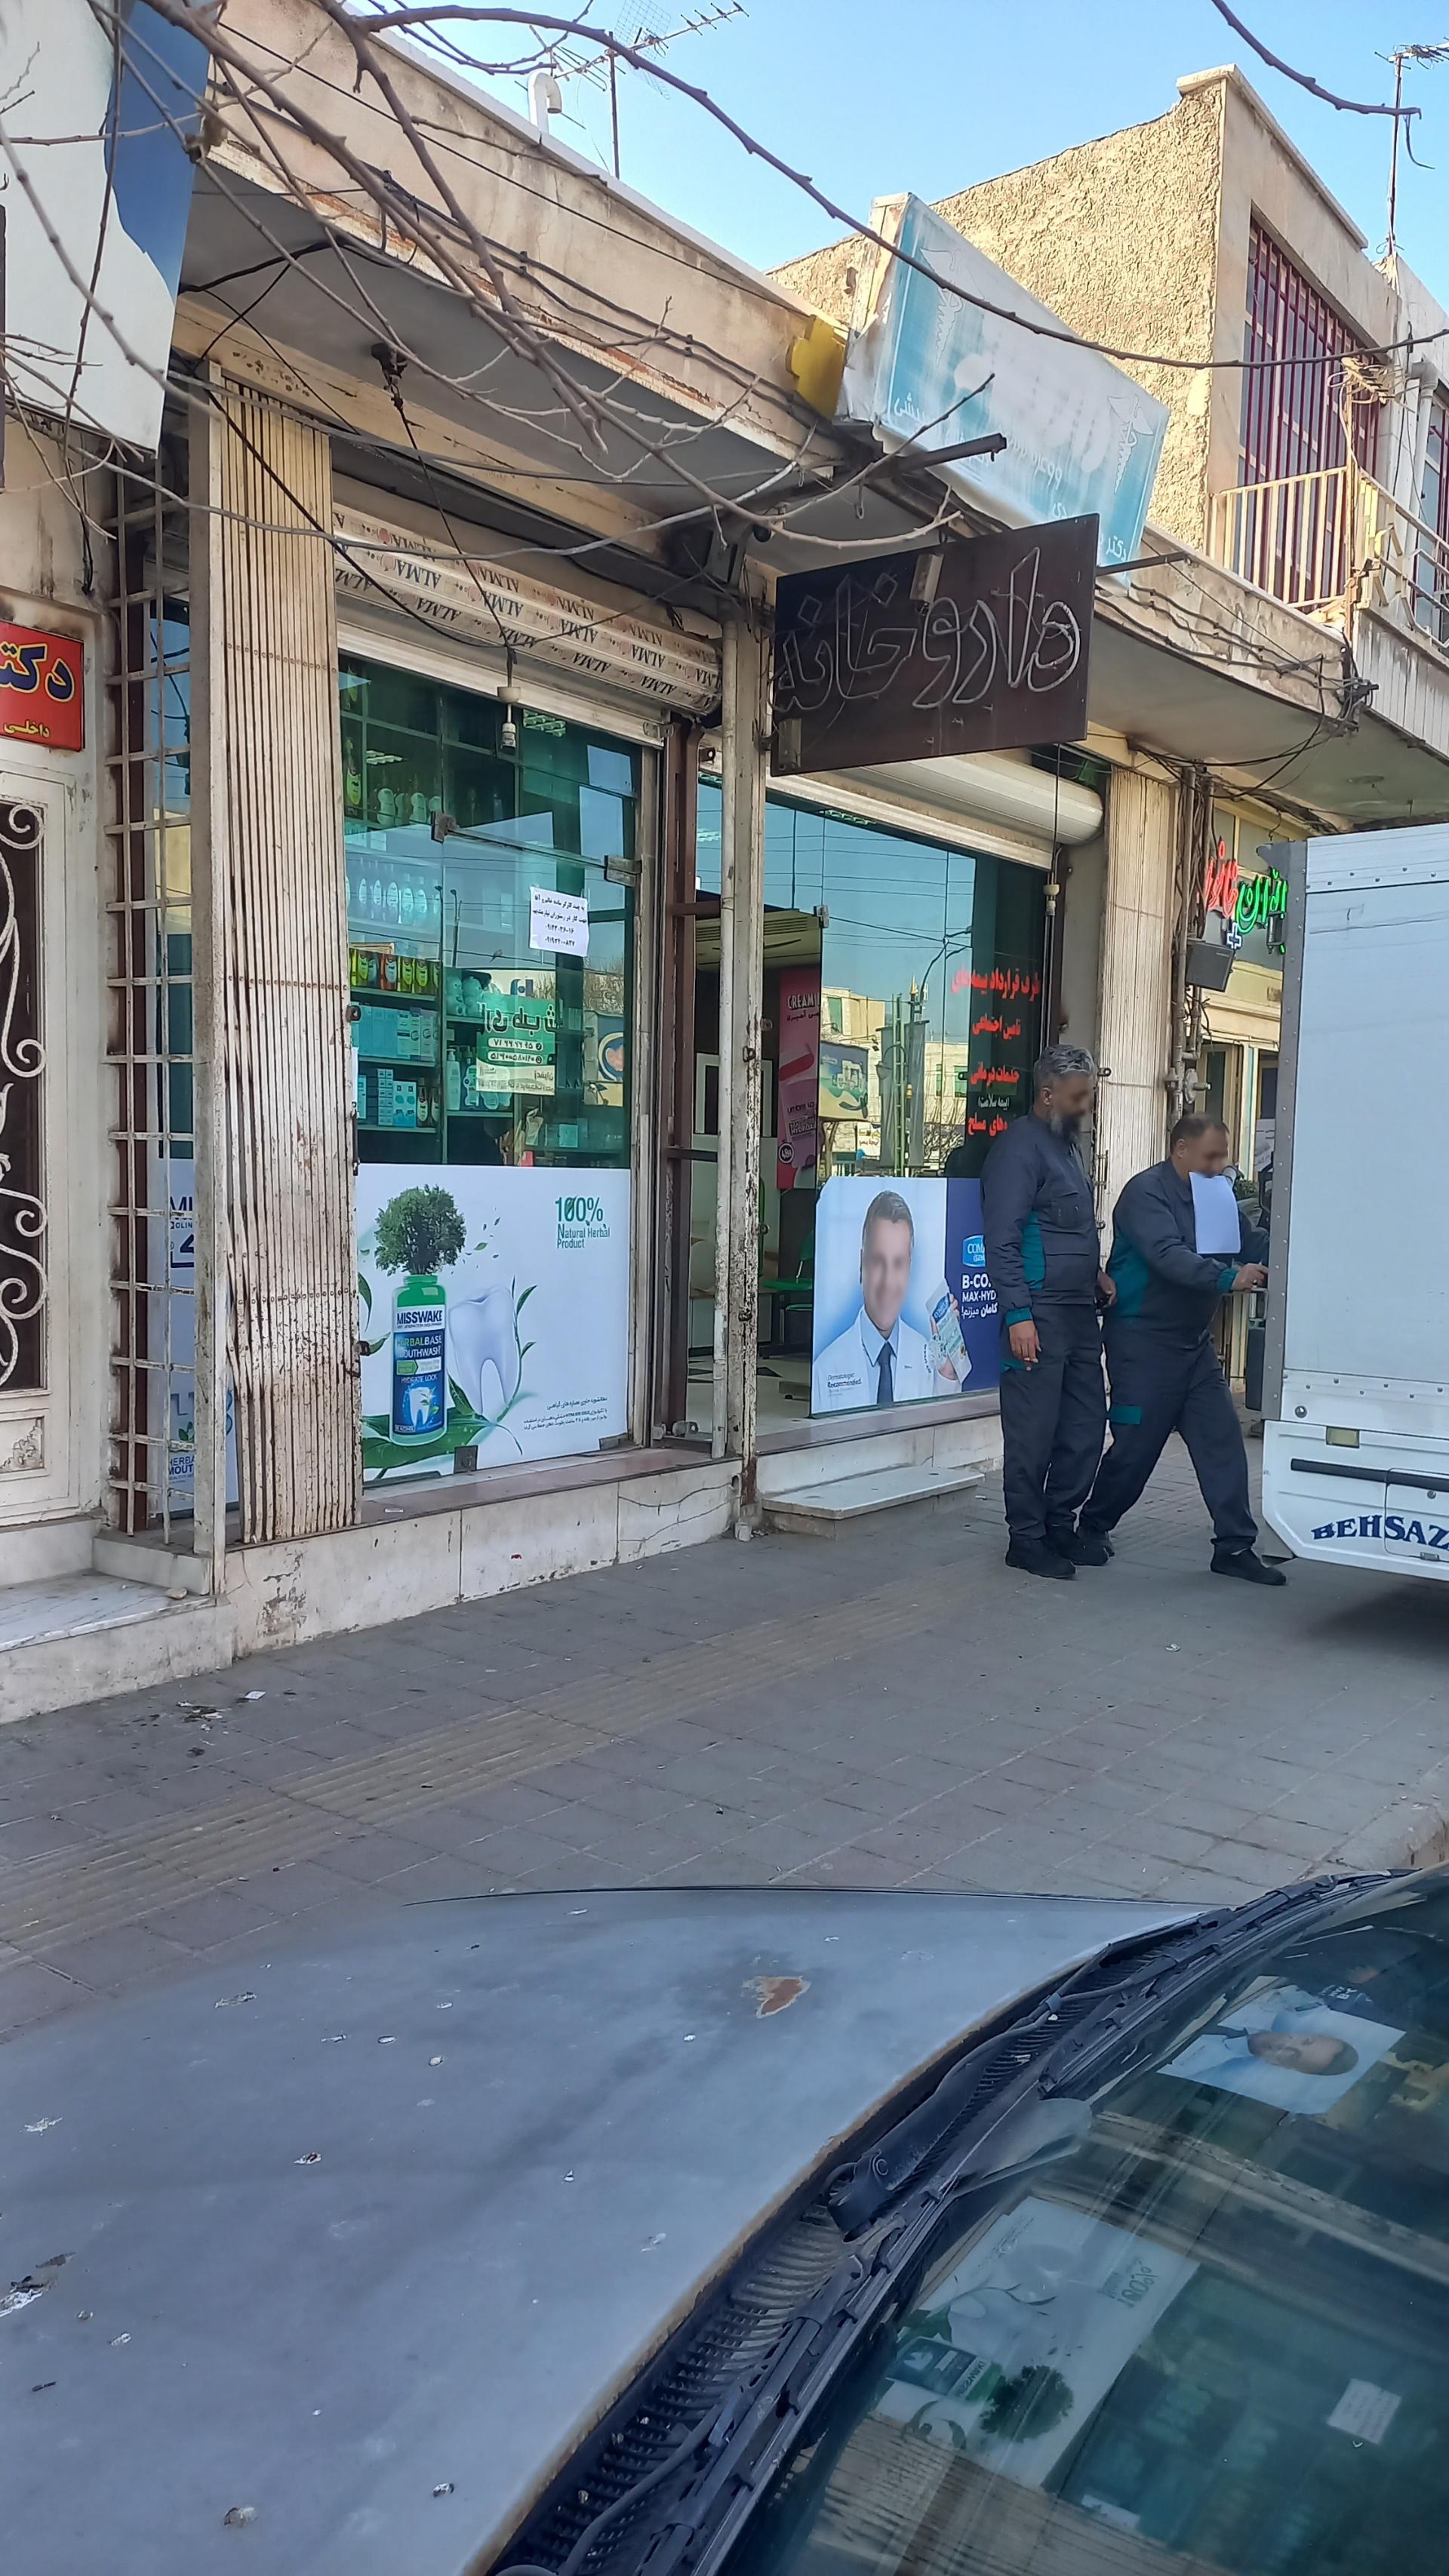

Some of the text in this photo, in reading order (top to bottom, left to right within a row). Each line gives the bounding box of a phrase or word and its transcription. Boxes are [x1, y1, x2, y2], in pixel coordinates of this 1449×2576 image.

[396, 559, 442, 589] ALMA
[479, 566, 519, 593] ALMA
[416, 596, 462, 622] ALMA
[481, 589, 525, 618] ALMA
[498, 626, 538, 649] ALMA
[560, 618, 598, 644] ALMA
[573, 651, 612, 673] ALMA
[632, 643, 666, 669] ALMA
[0, 642, 74, 703] دکت
[641, 675, 678, 696] ALMA
[4, 719, 51, 738] داخلی
[989, 966, 1020, 1000] قرارداد
[786, 993, 814, 1010] CREAM
[971, 1012, 1021, 1041] تامین اجتماعی
[969, 1061, 1020, 1088] خدمات درمانی
[968, 1112, 986, 1135] مسلح
[555, 1196, 604, 1222] 100%
[556, 1238, 586, 1249] Product
[557, 1223, 611, 1239] Natural Herbal
[397, 1310, 443, 1325] MISSWAKE
[170, 1455, 195, 1467] HERBA
[1311, 1514, 1449, 1550] BEHSAZ
